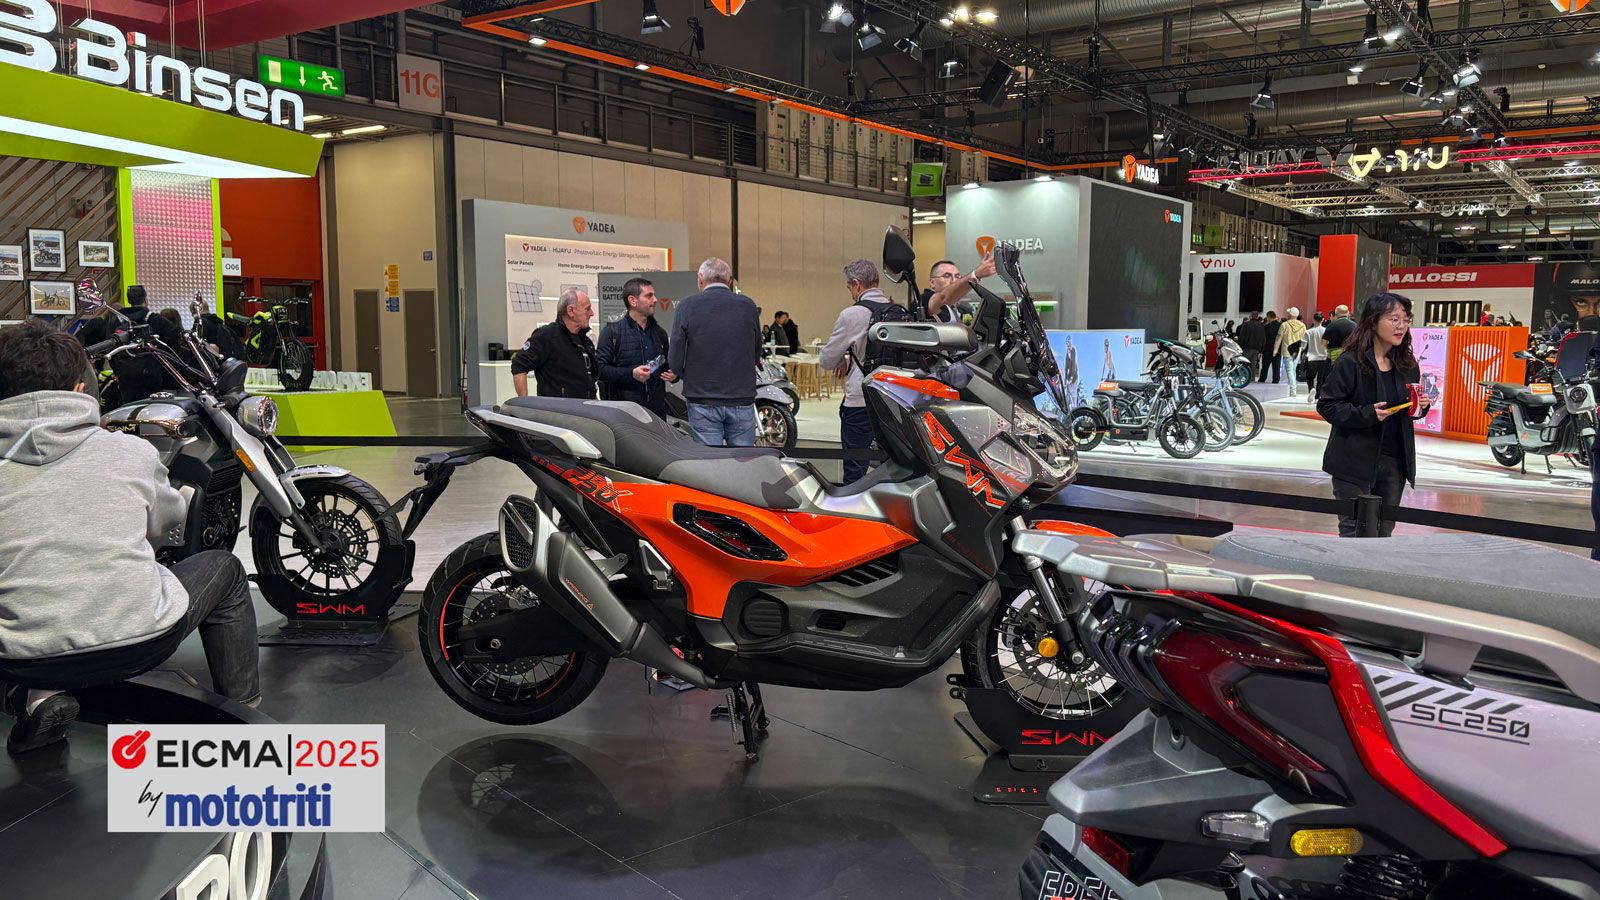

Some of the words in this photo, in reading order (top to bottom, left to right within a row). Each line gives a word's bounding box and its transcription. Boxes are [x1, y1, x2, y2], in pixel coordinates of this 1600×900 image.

[74, 18, 305, 132] Binsen
[400, 69, 440, 98] 11G
[1136, 163, 1160, 184] YADEA
[587, 221, 616, 233] YADEA
[619, 252, 635, 260] Storage
[923, 411, 1007, 508] SWM
[296, 602, 365, 615] SWM
[1410, 703, 1530, 738] SC250
